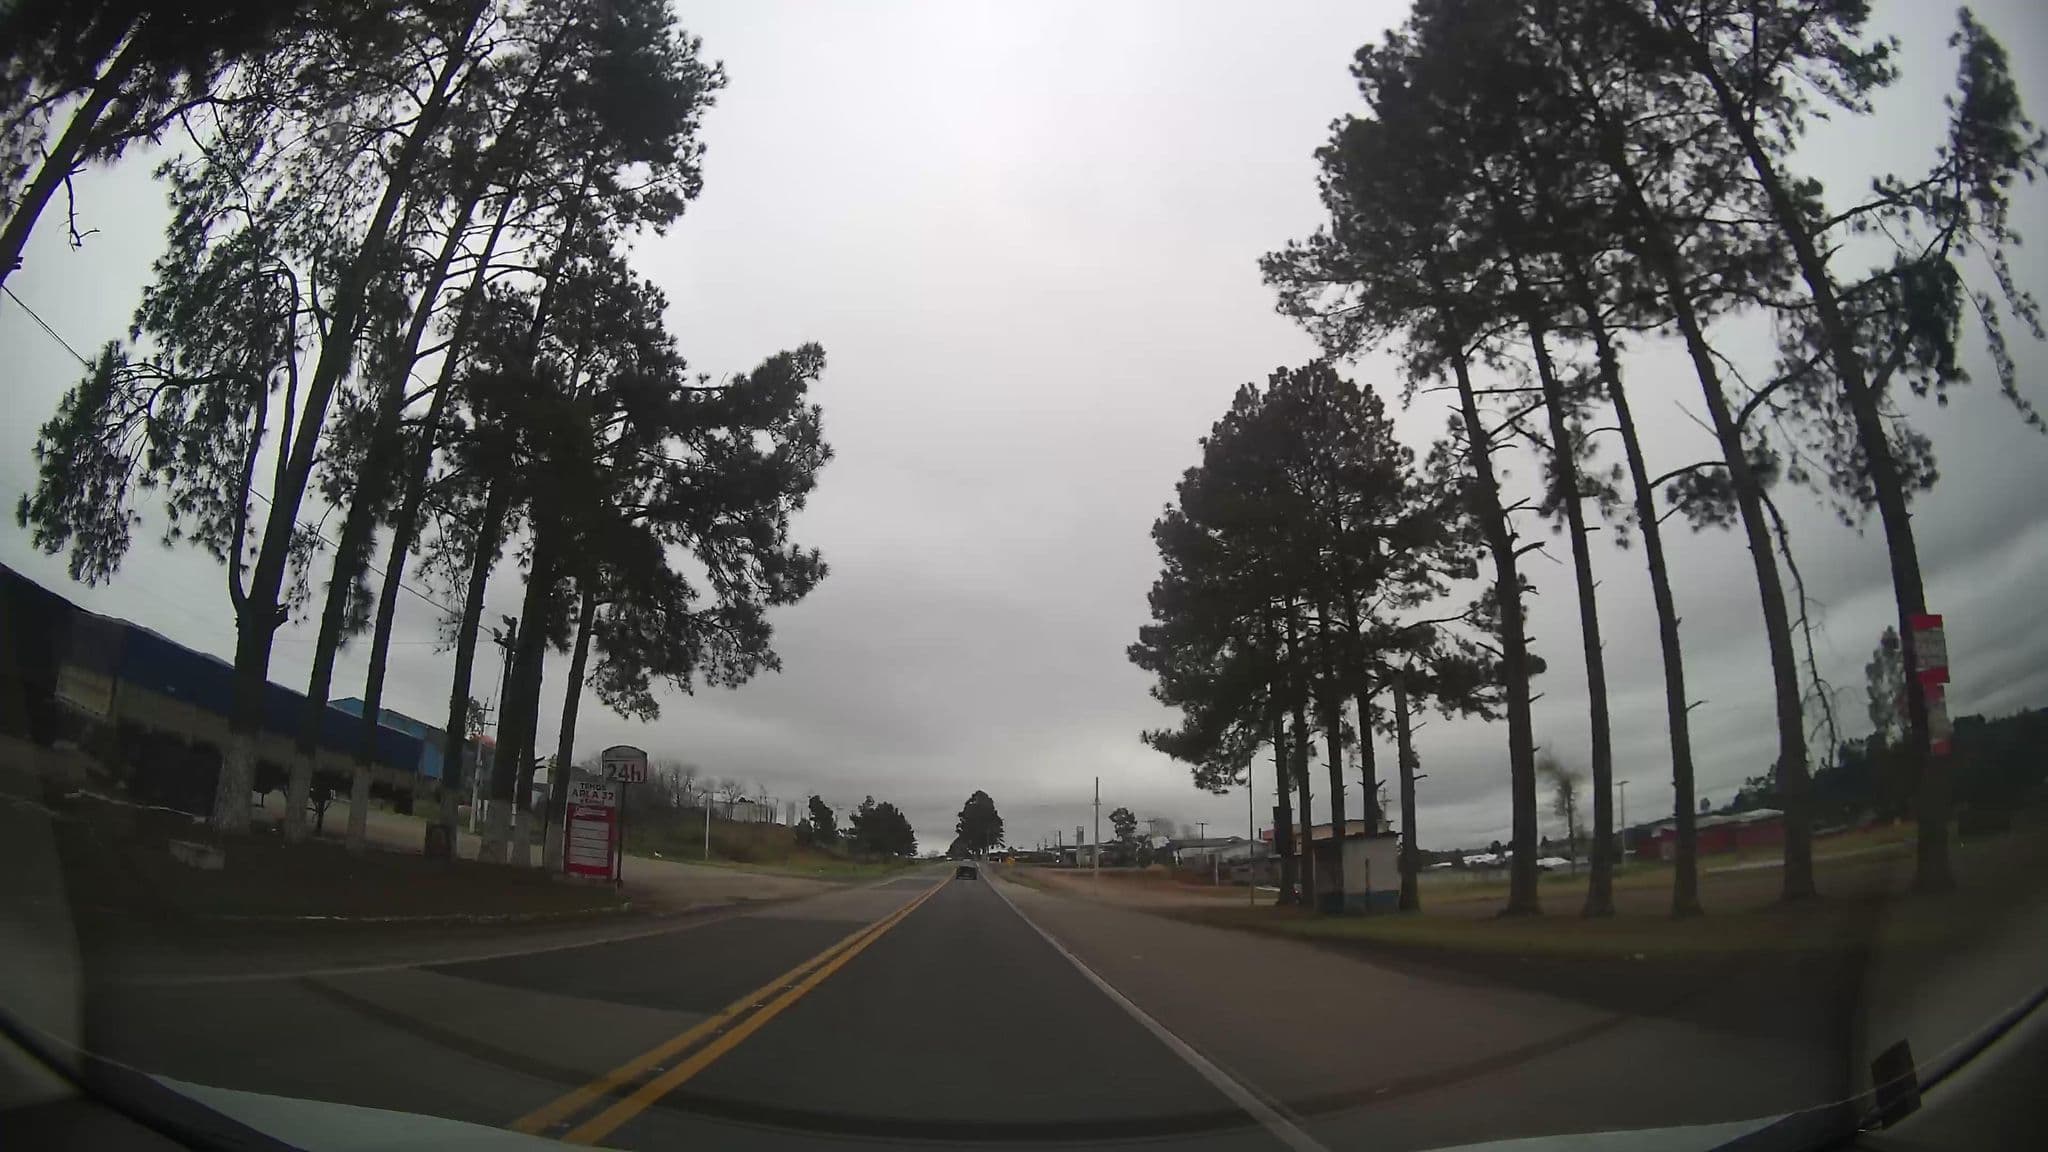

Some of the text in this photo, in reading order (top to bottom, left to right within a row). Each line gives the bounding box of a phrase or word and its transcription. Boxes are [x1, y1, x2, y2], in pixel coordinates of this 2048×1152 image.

[606, 763, 641, 781] 24h
[580, 782, 607, 791] TEMOS
[572, 789, 614, 801] ARLA 32
